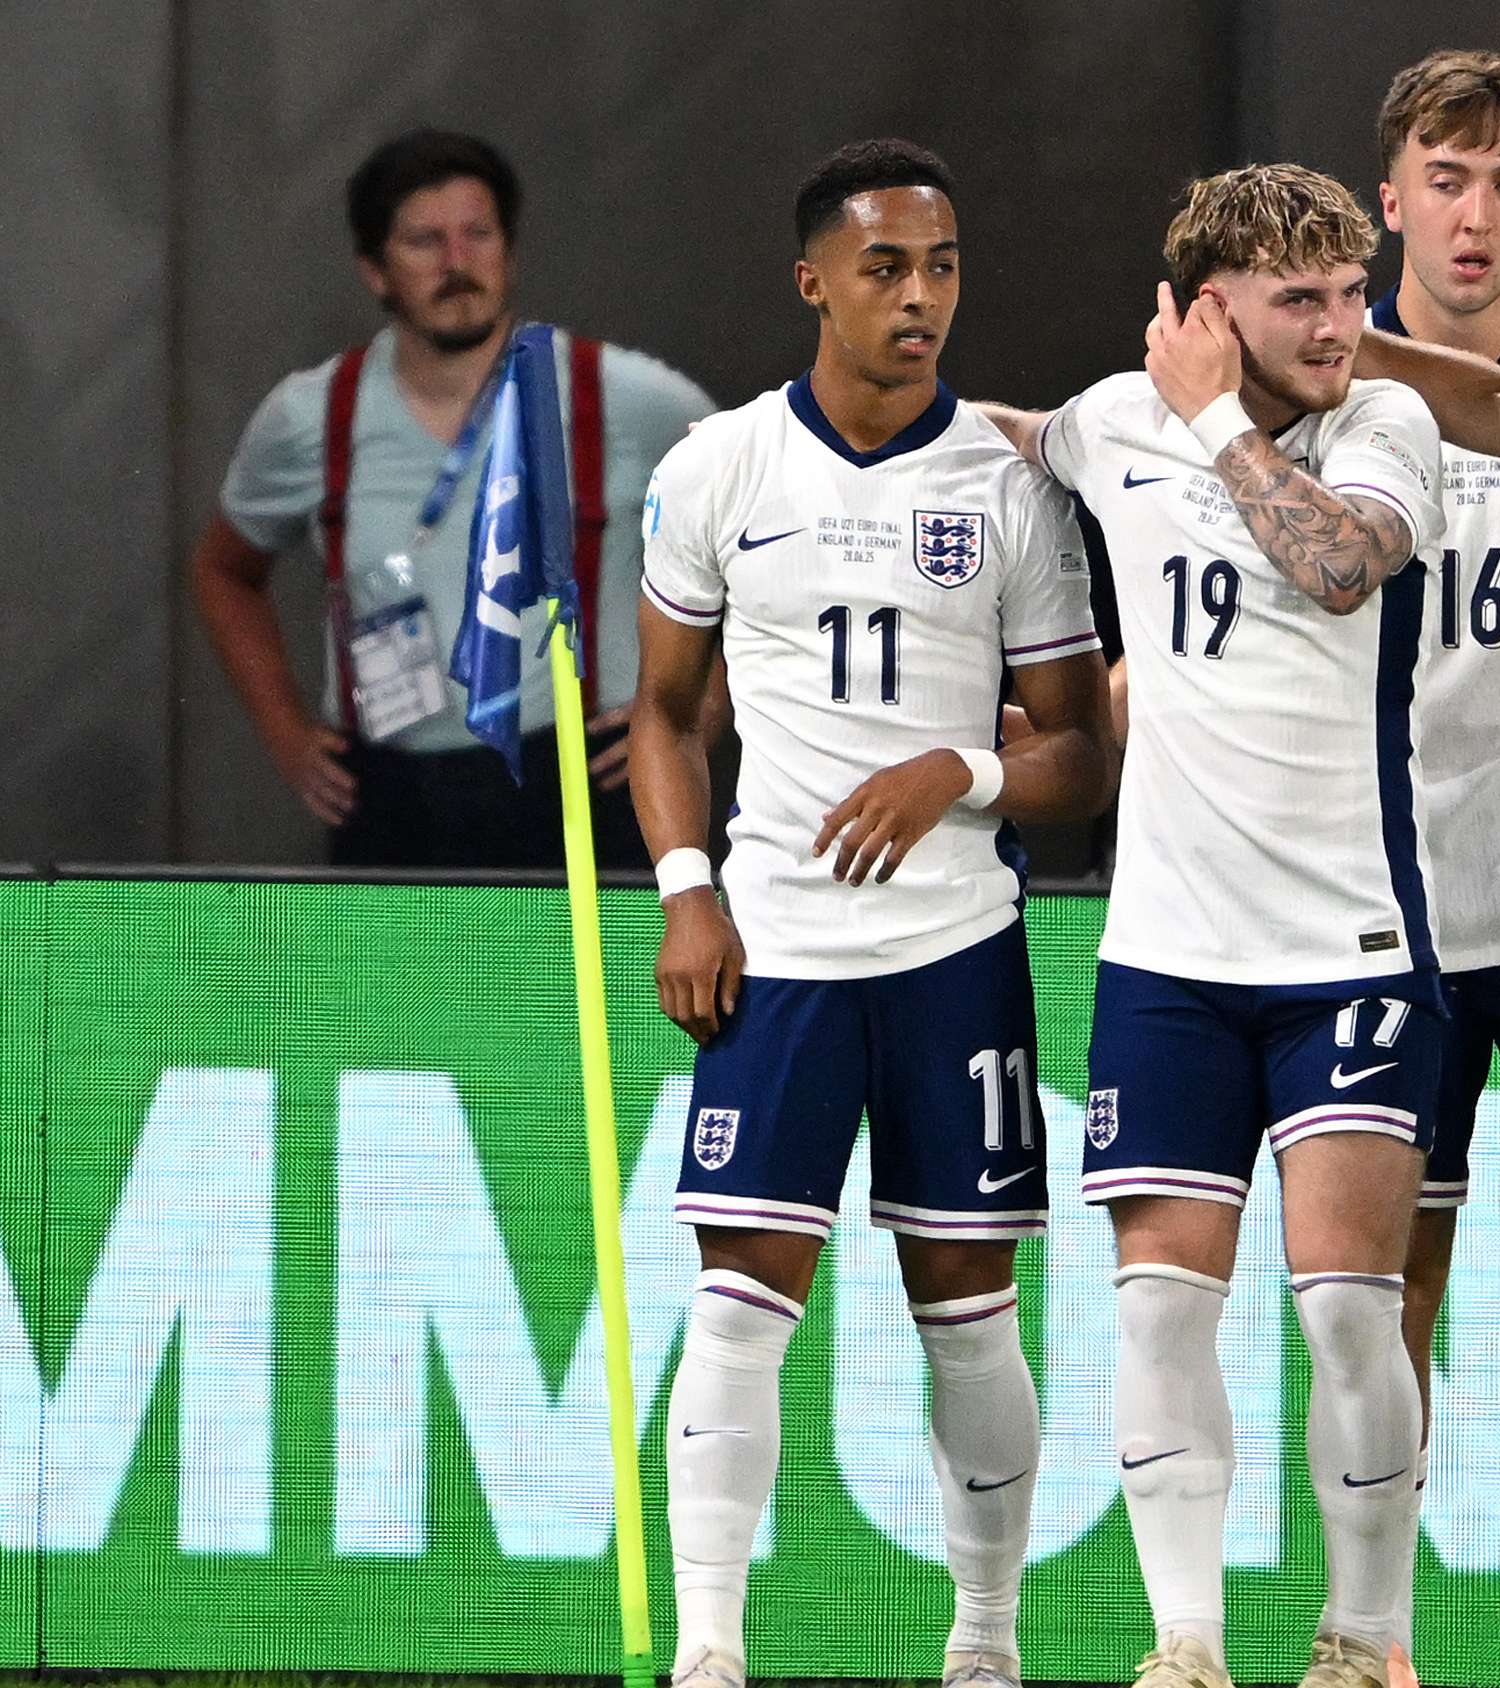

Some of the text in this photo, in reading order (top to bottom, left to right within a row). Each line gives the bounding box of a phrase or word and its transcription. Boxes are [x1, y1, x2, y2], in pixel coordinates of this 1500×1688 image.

[1467, 460, 1487, 473] EURO
[818, 517, 902, 534] UEFA U21 EURO FINAL
[818, 532, 855, 546] ENGLAND
[864, 534, 902, 550] GERMANY
[1163, 555, 1242, 660] 19
[818, 605, 901, 705] 11
[968, 1048, 1035, 1151] 11
